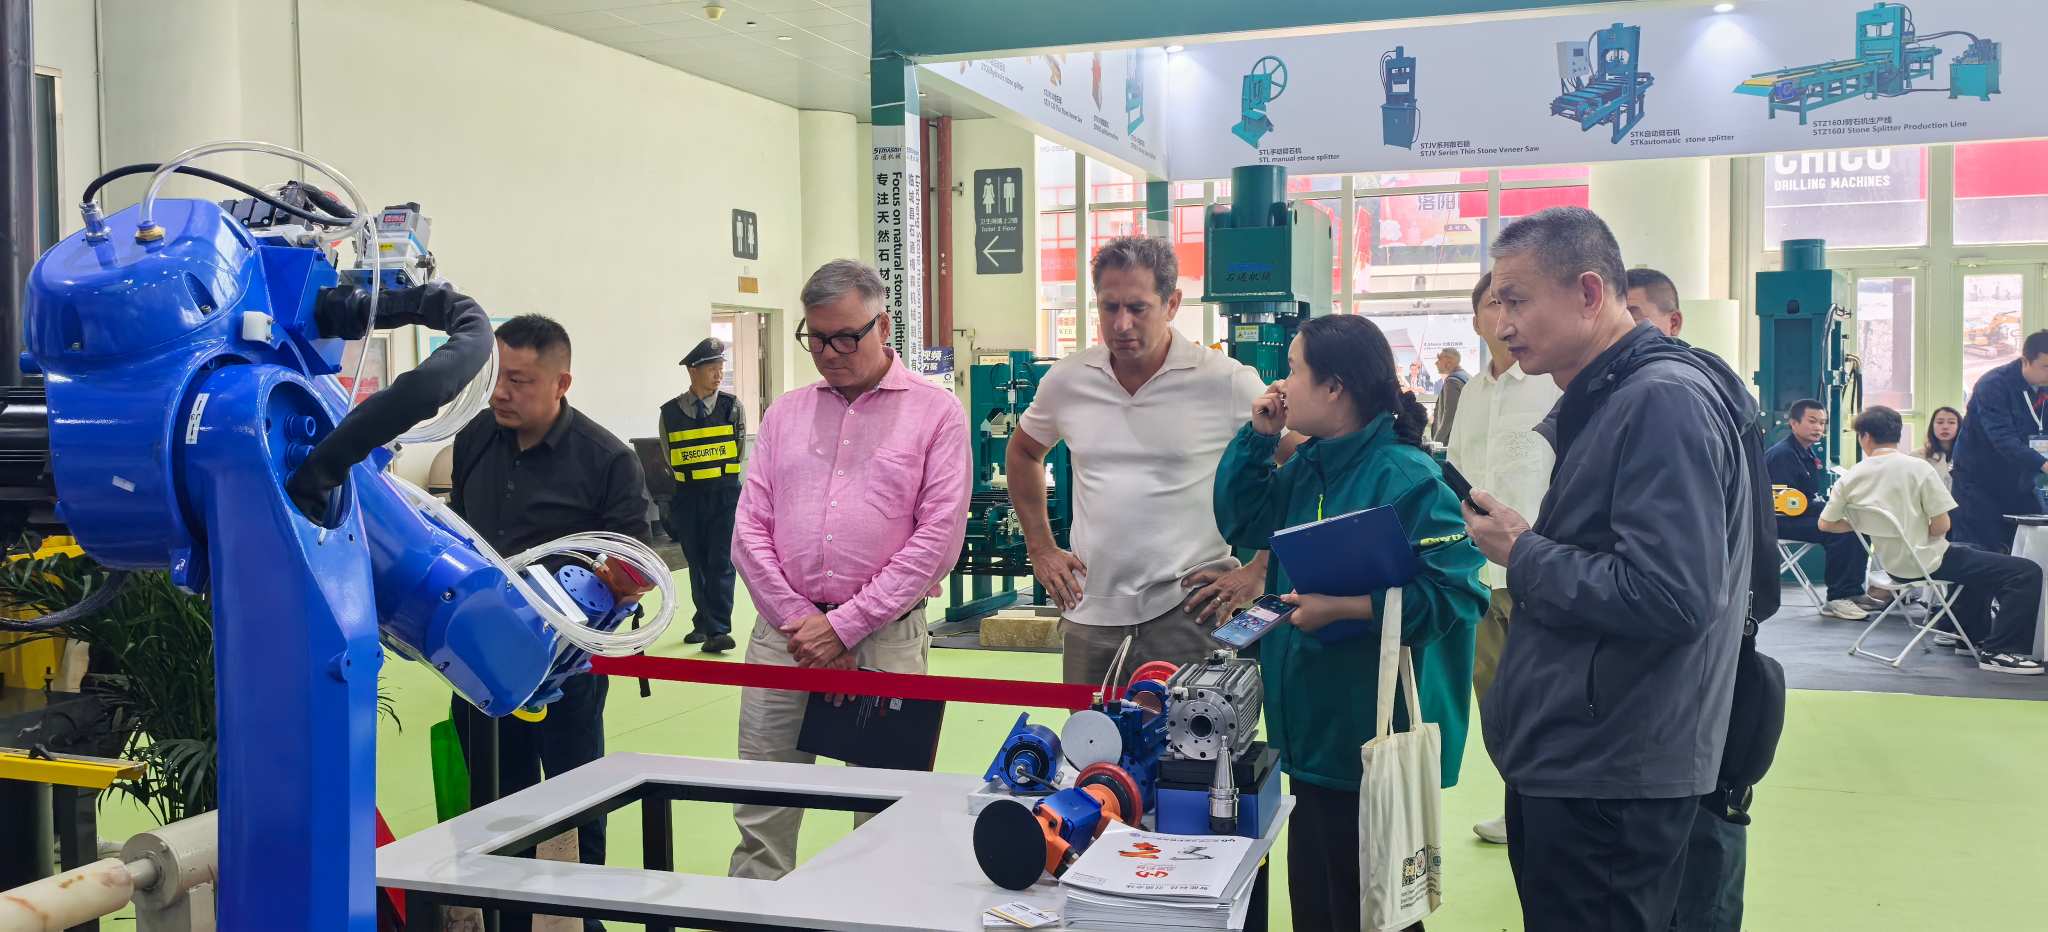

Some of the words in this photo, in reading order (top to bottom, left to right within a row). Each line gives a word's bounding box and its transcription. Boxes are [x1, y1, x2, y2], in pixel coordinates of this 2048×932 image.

[1848, 126, 1870, 134] Stone
[1872, 124, 1902, 133] Splitter
[1904, 121, 1948, 131] Production
[1950, 120, 1968, 128] Line
[1684, 135, 1706, 143] stone
[1708, 134, 1735, 143] splitter
[1316, 152, 1341, 161] splitter
[1438, 148, 1459, 156] Series
[1461, 147, 1476, 155] Thin
[1477, 146, 1498, 154] Stone
[1499, 145, 1523, 153] Veneer
[1525, 144, 1540, 153] Saw
[892, 171, 903, 207] Focus
[1774, 178, 1826, 191] DRILLING
[1830, 175, 1891, 189] MACHINES
[892, 209, 902, 226] on
[892, 228, 904, 271] natural
[876, 172, 891, 347] 专注天然石材
[893, 273, 904, 308] stone
